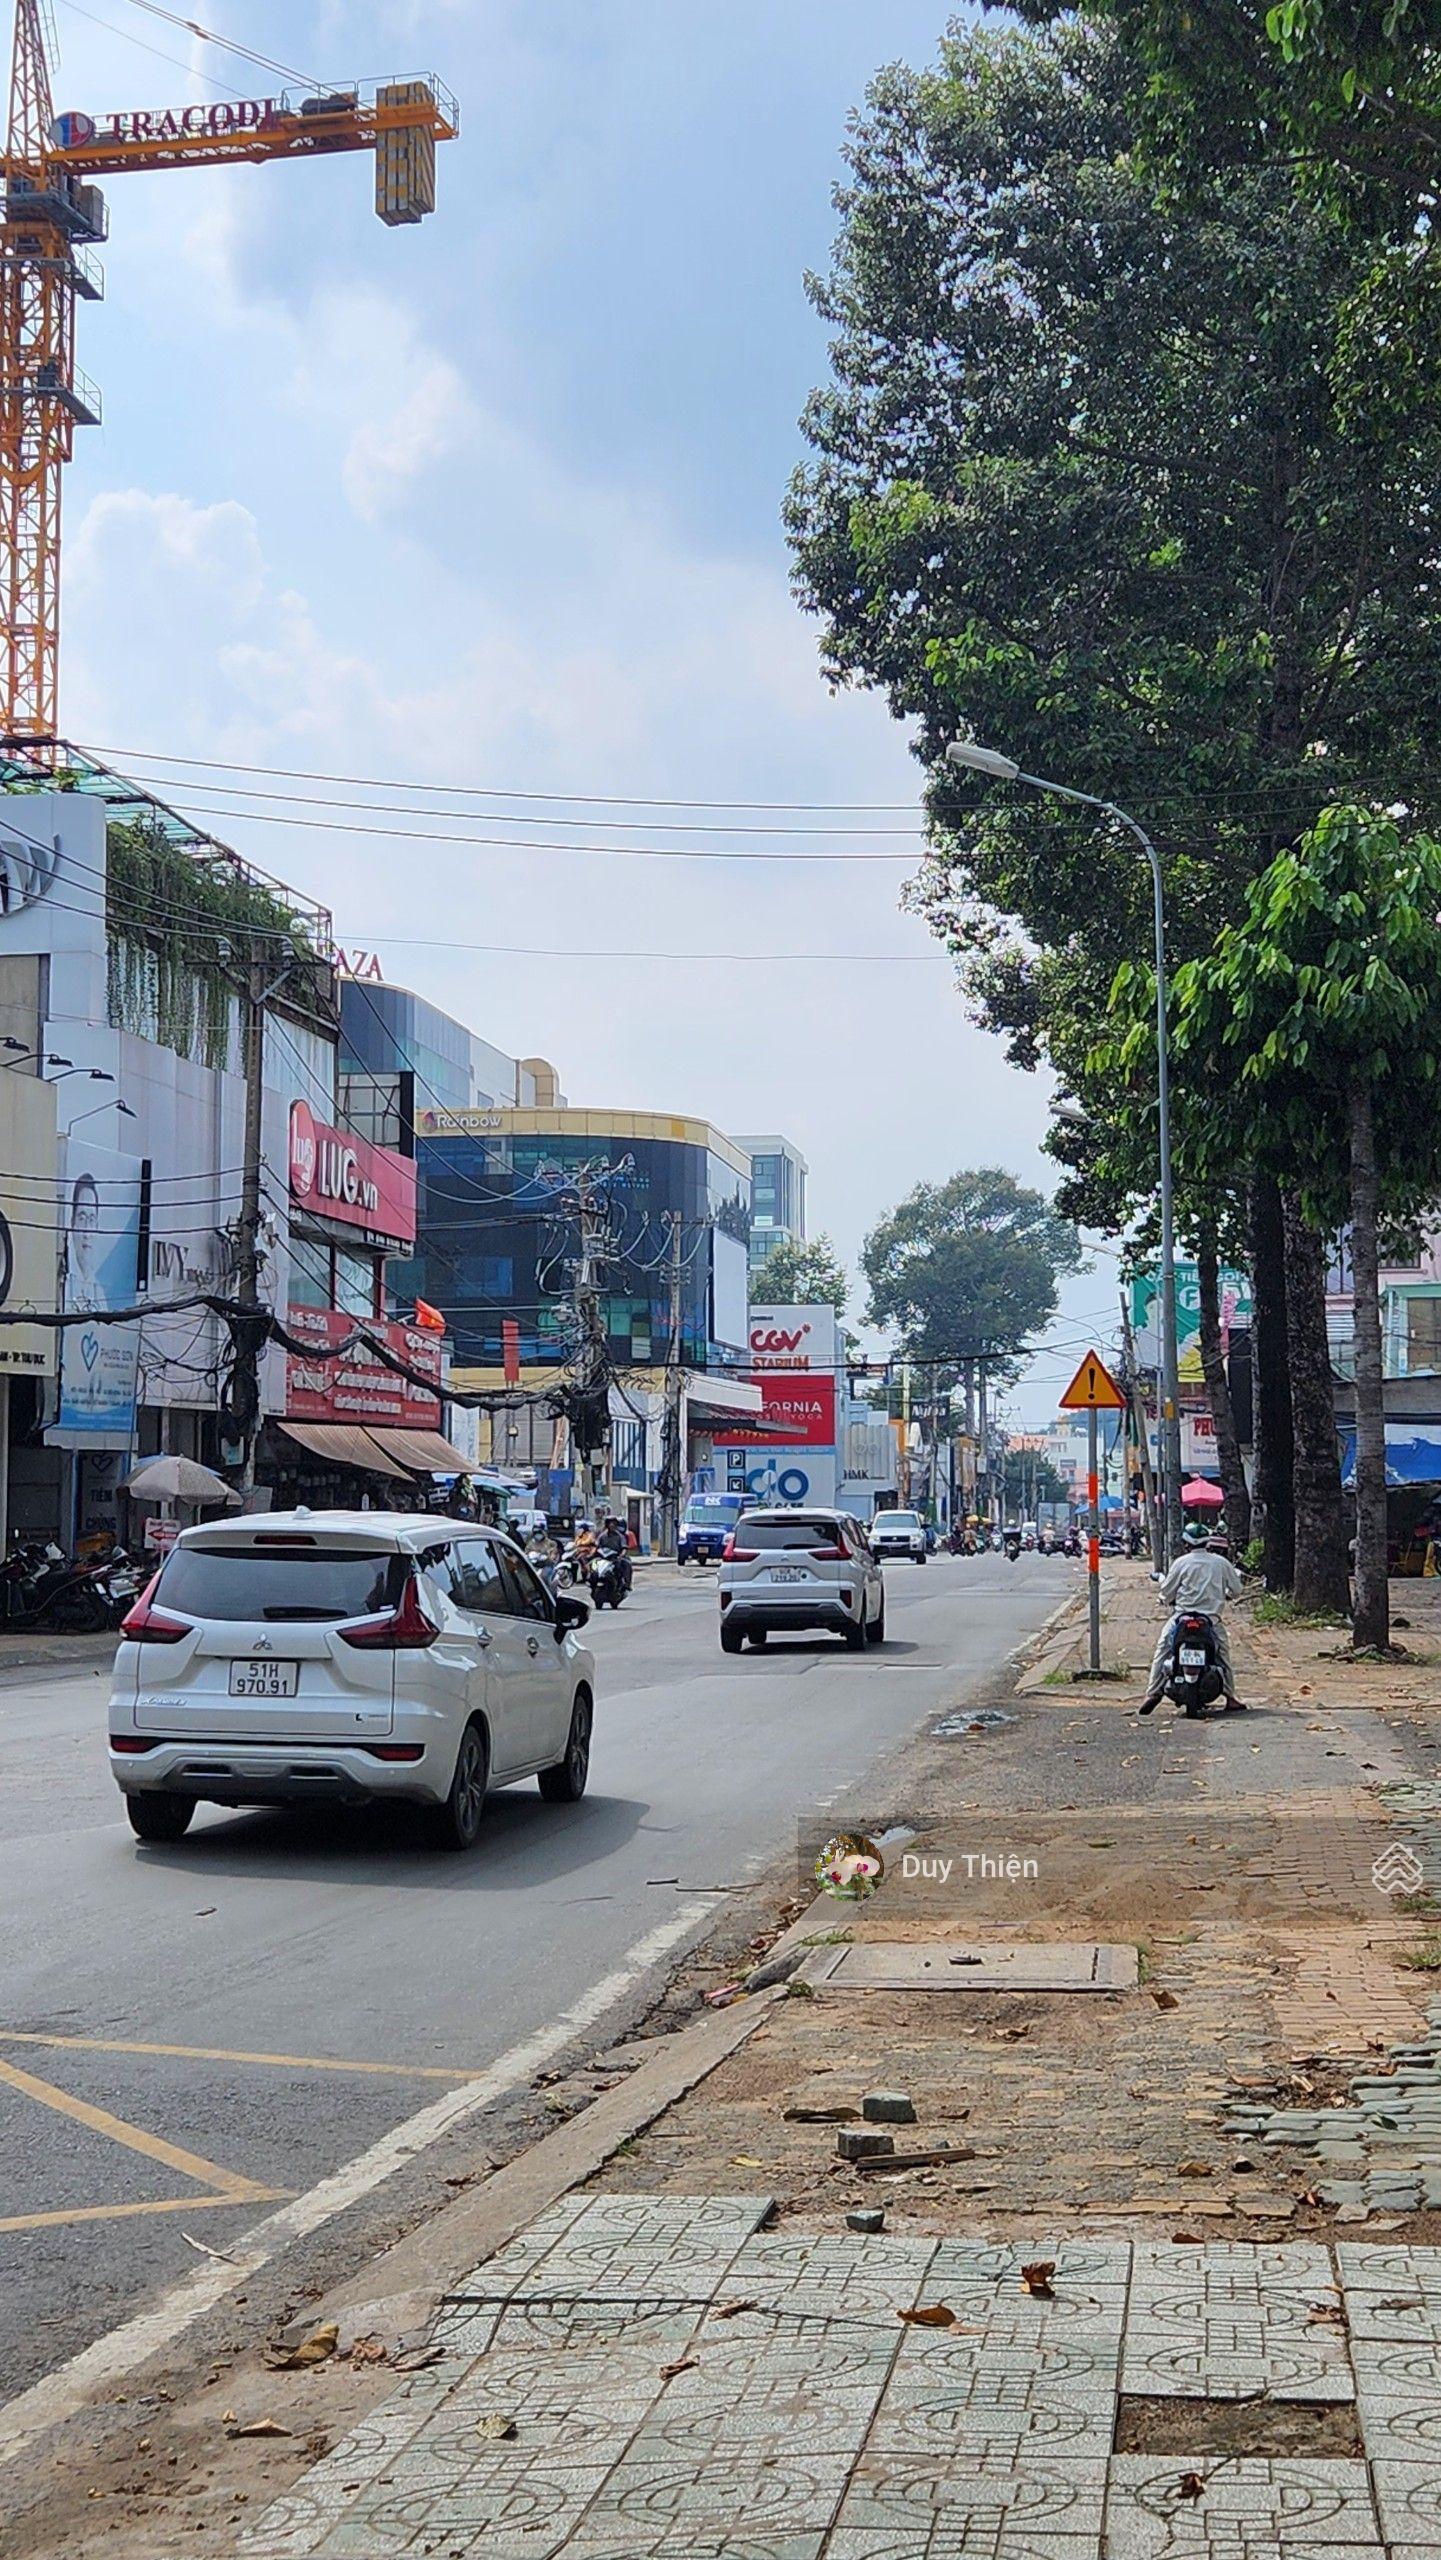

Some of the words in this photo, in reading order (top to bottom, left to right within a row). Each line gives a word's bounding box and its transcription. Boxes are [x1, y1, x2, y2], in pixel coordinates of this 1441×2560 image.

[106, 98, 276, 140] TRACODI
[333, 948, 384, 981] AZA
[436, 1113, 502, 1129] Rainbow
[750, 1329, 803, 1352] CGV
[761, 1401, 823, 1413] FORNIA
[250, 1663, 278, 1677] 51H
[236, 1679, 288, 1695] 970.91
